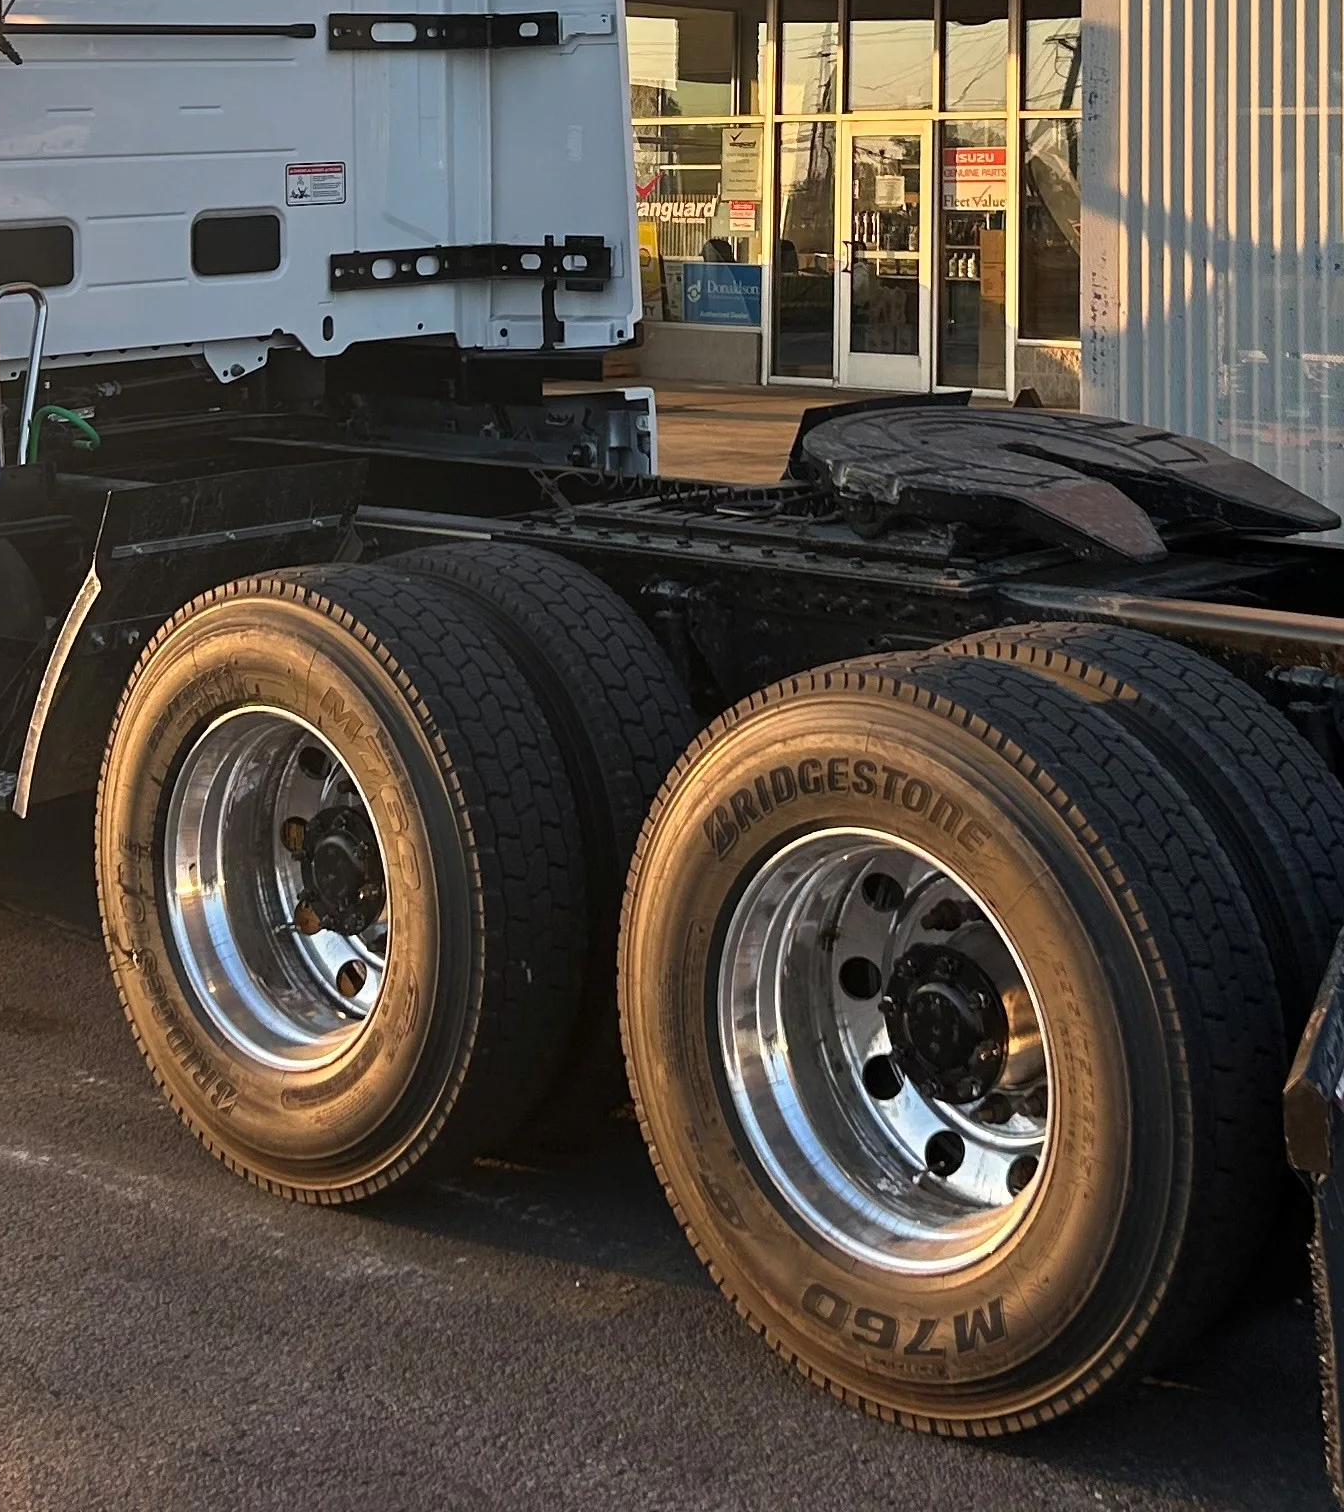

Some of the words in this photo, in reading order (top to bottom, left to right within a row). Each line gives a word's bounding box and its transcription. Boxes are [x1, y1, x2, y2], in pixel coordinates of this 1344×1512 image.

[956, 152, 995, 164] ISUZU
[943, 194, 970, 208] Fleet
[702, 756, 993, 862] BRIDGESTONE
